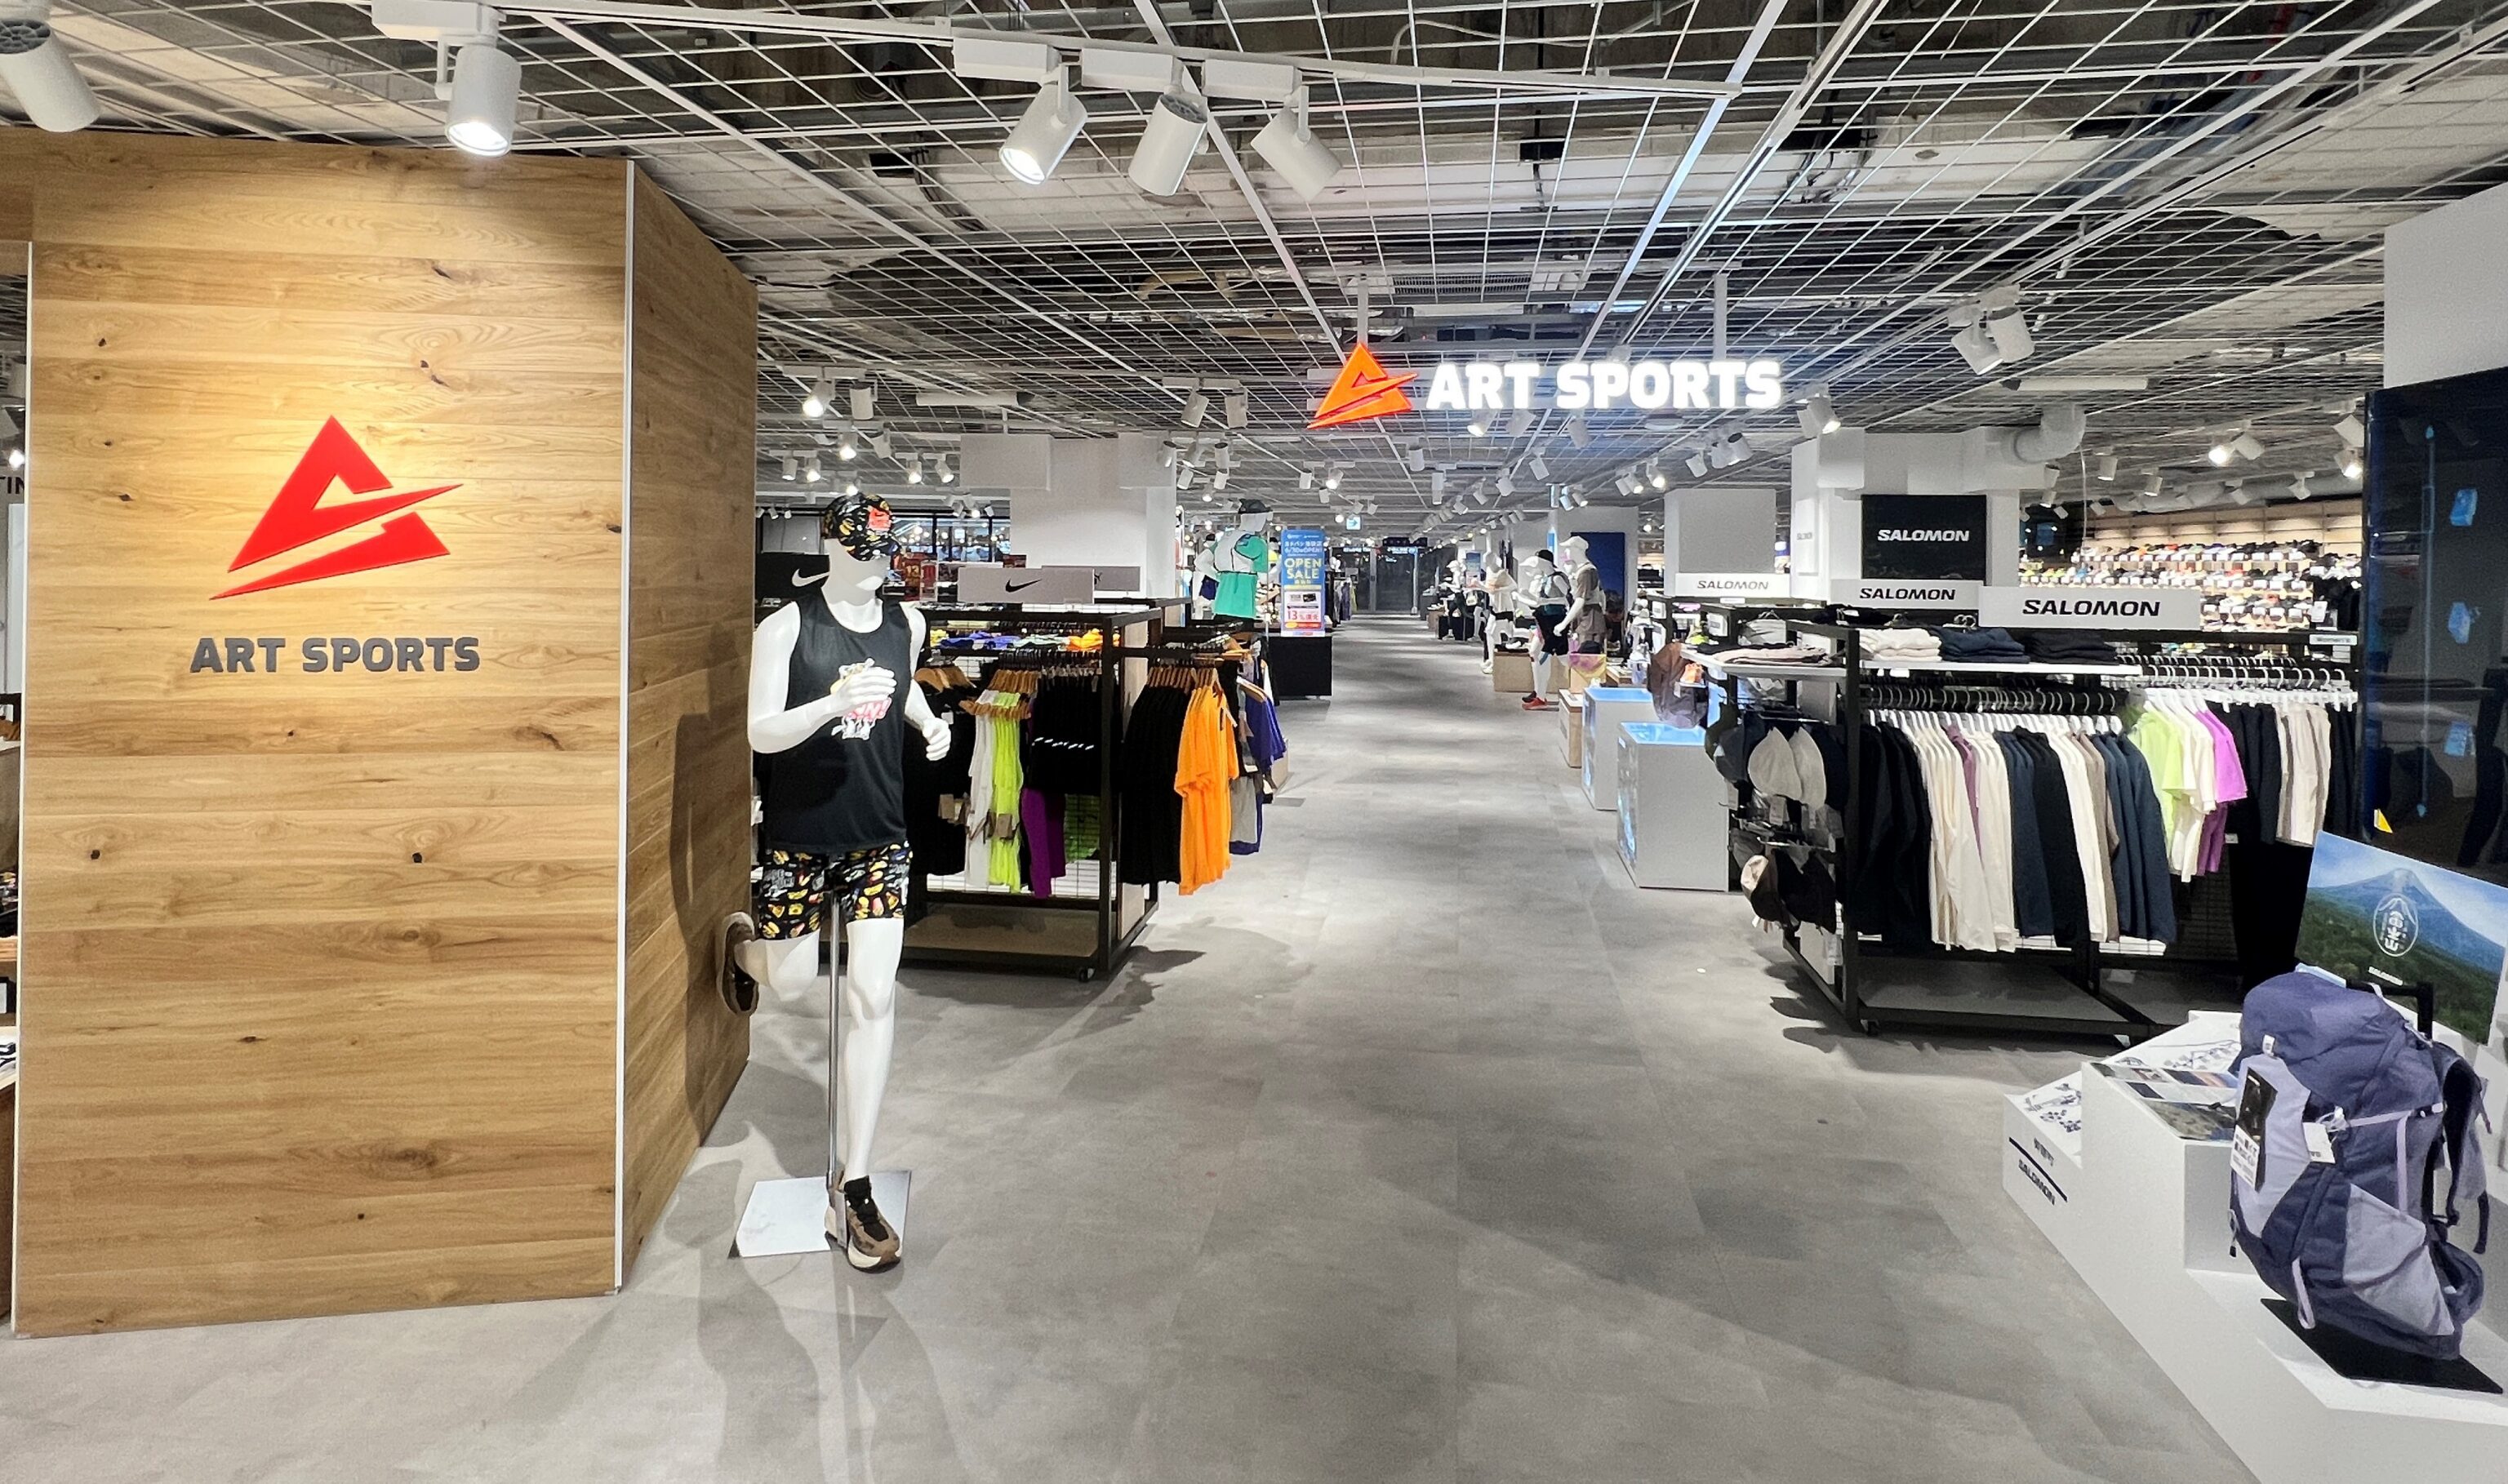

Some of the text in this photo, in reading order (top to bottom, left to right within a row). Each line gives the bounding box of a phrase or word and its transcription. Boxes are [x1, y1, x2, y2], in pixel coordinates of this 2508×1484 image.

[1426, 362, 1781, 409] ART SPORTS
[1878, 529, 1969, 542] SALOMON
[1284, 558, 1322, 568] OPEN
[1287, 568, 1319, 579] SALE
[1697, 580, 1768, 590] SALOMON
[1860, 587, 1956, 601] SALOMON
[2022, 599, 2161, 616] SALOMON
[190, 638, 480, 673] ART SPORTS
